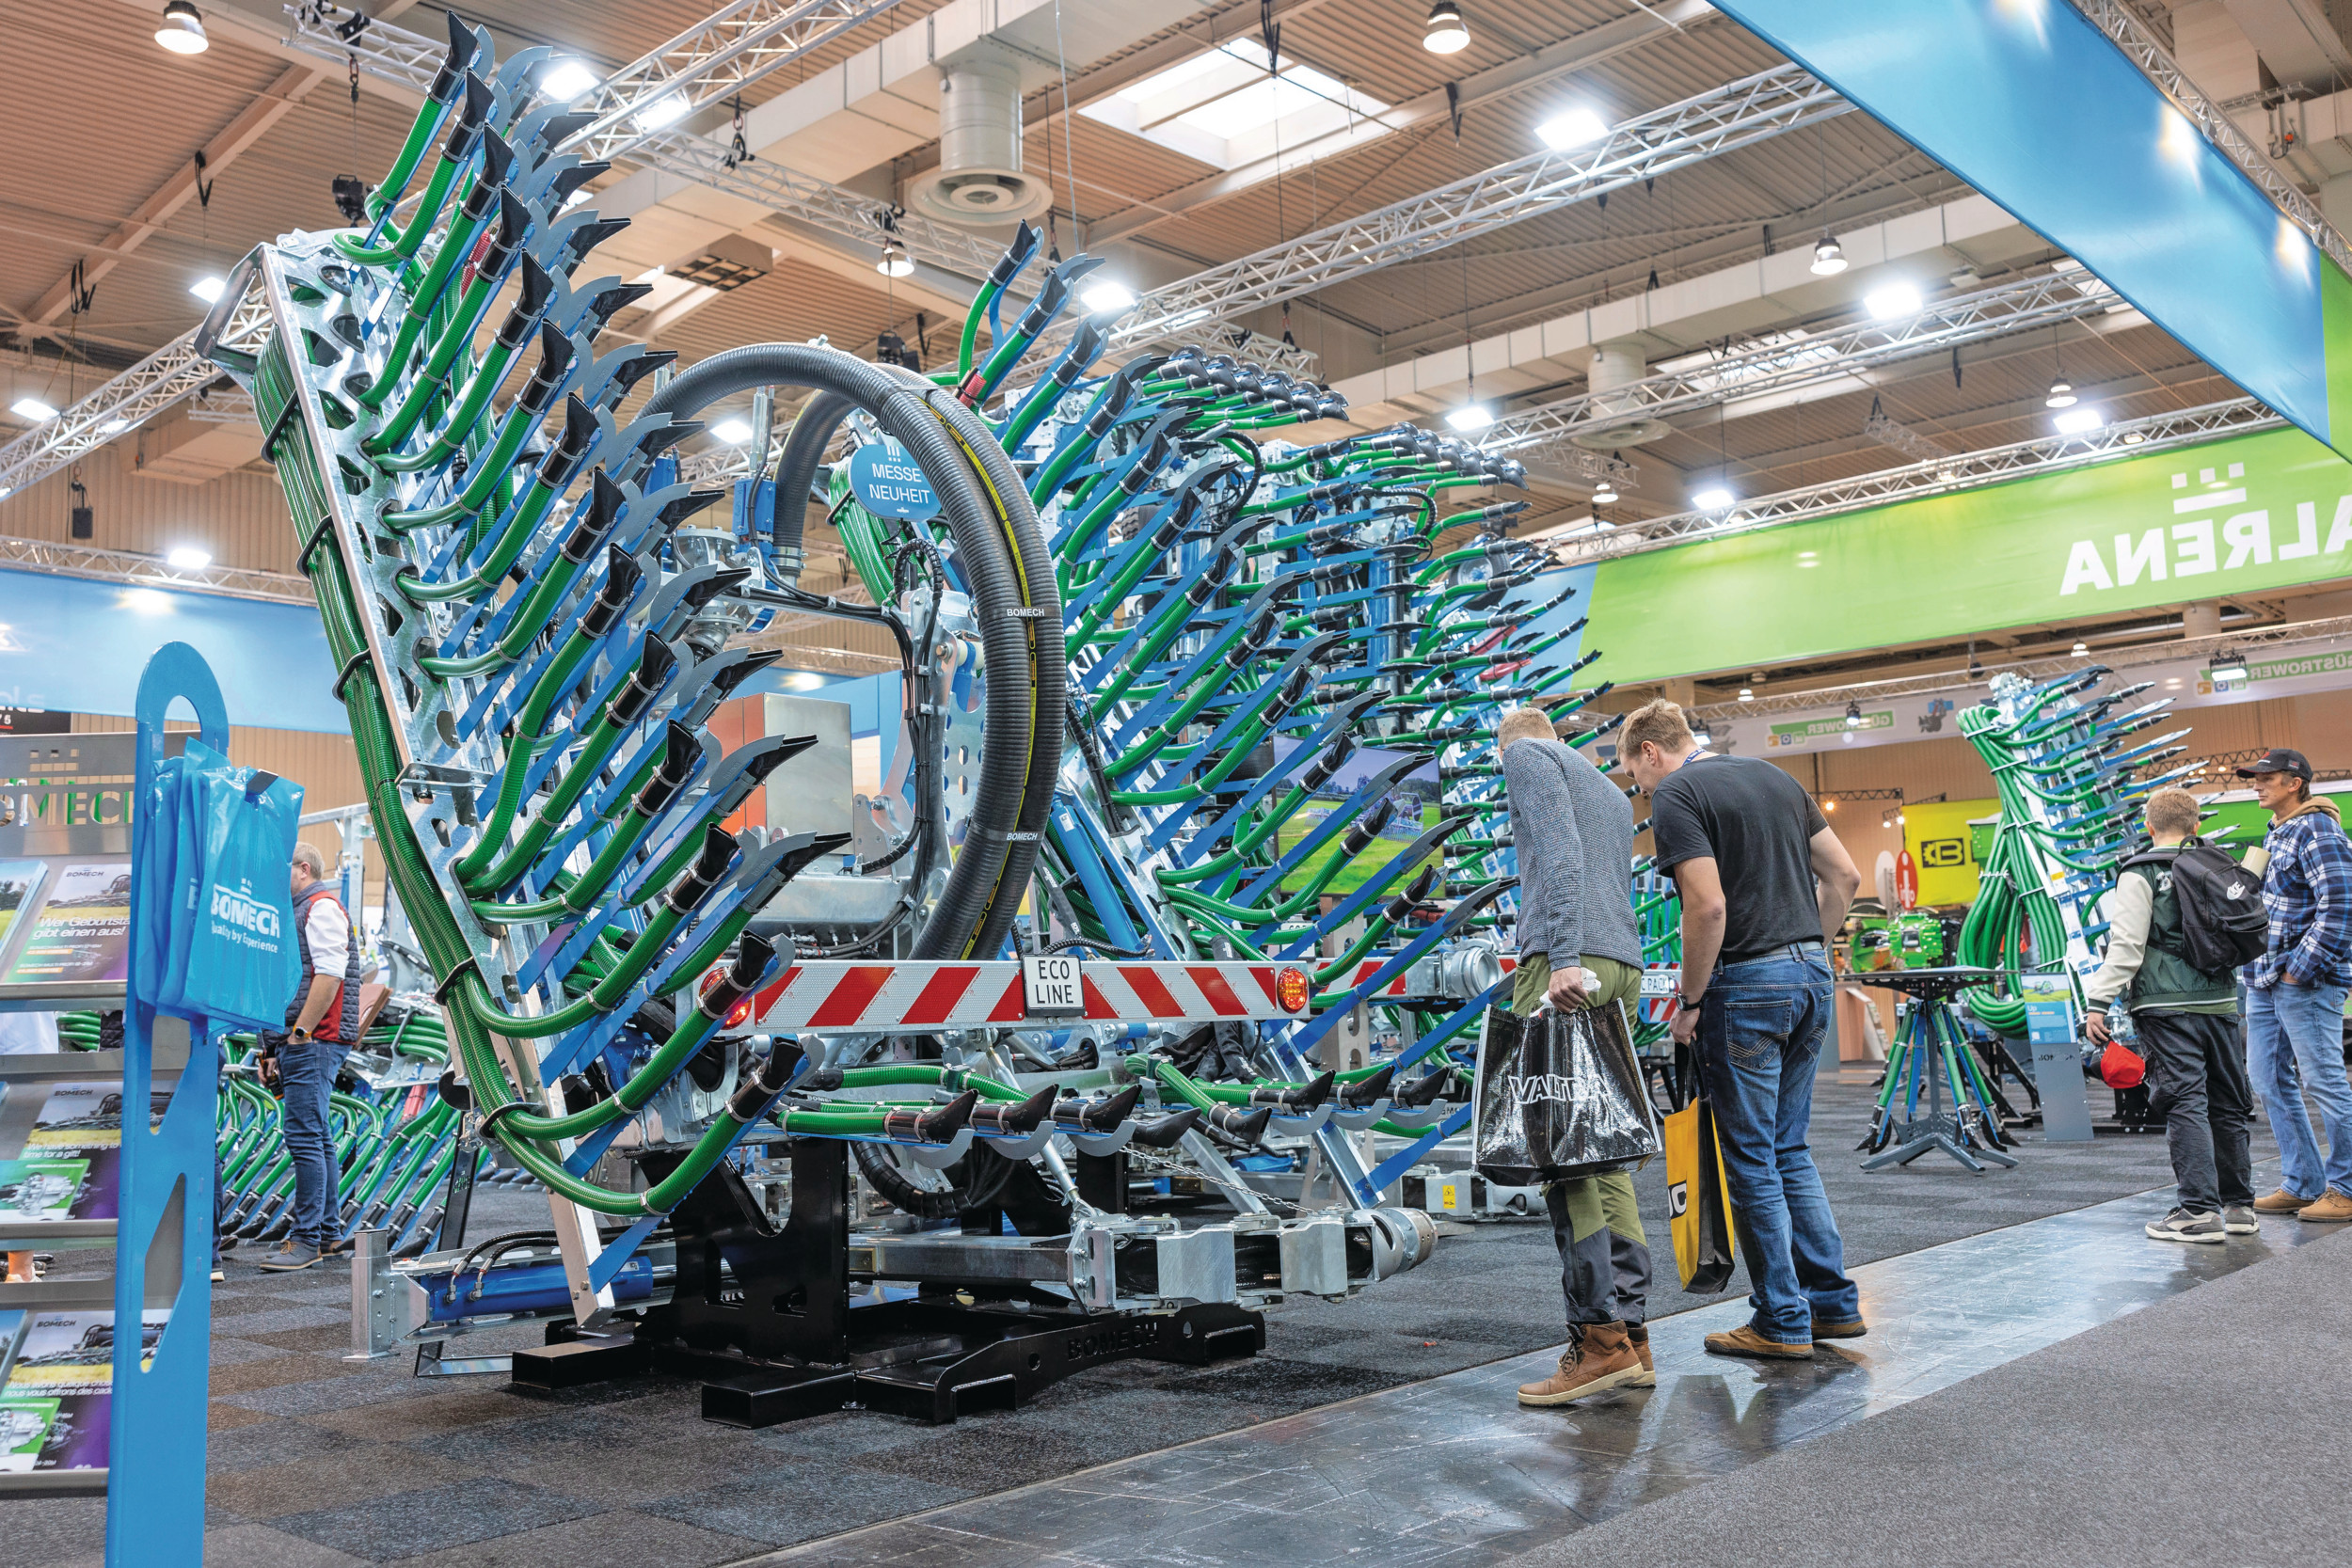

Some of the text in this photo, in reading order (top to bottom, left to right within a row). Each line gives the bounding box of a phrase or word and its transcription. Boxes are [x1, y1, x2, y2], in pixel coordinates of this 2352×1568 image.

[872, 463, 922, 483] MESSE
[868, 483, 930, 504] NEUHEIT
[1007, 608, 1045, 617] BOMECH
[1007, 832, 1038, 841] BOMECH
[40, 917, 65, 927] Wer
[211, 891, 280, 939] BOMECH
[33, 927, 126, 940] gibt einen aus!
[212, 920, 278, 954] uality by Experience
[1039, 960, 1070, 979] ECO
[1035, 984, 1073, 1004] LINE
[23, 1150, 42, 1159] time
[43, 1149, 57, 1158] for
[1068, 1322, 1160, 1361] BOMECH
[5, 1389, 25, 1398] nous
